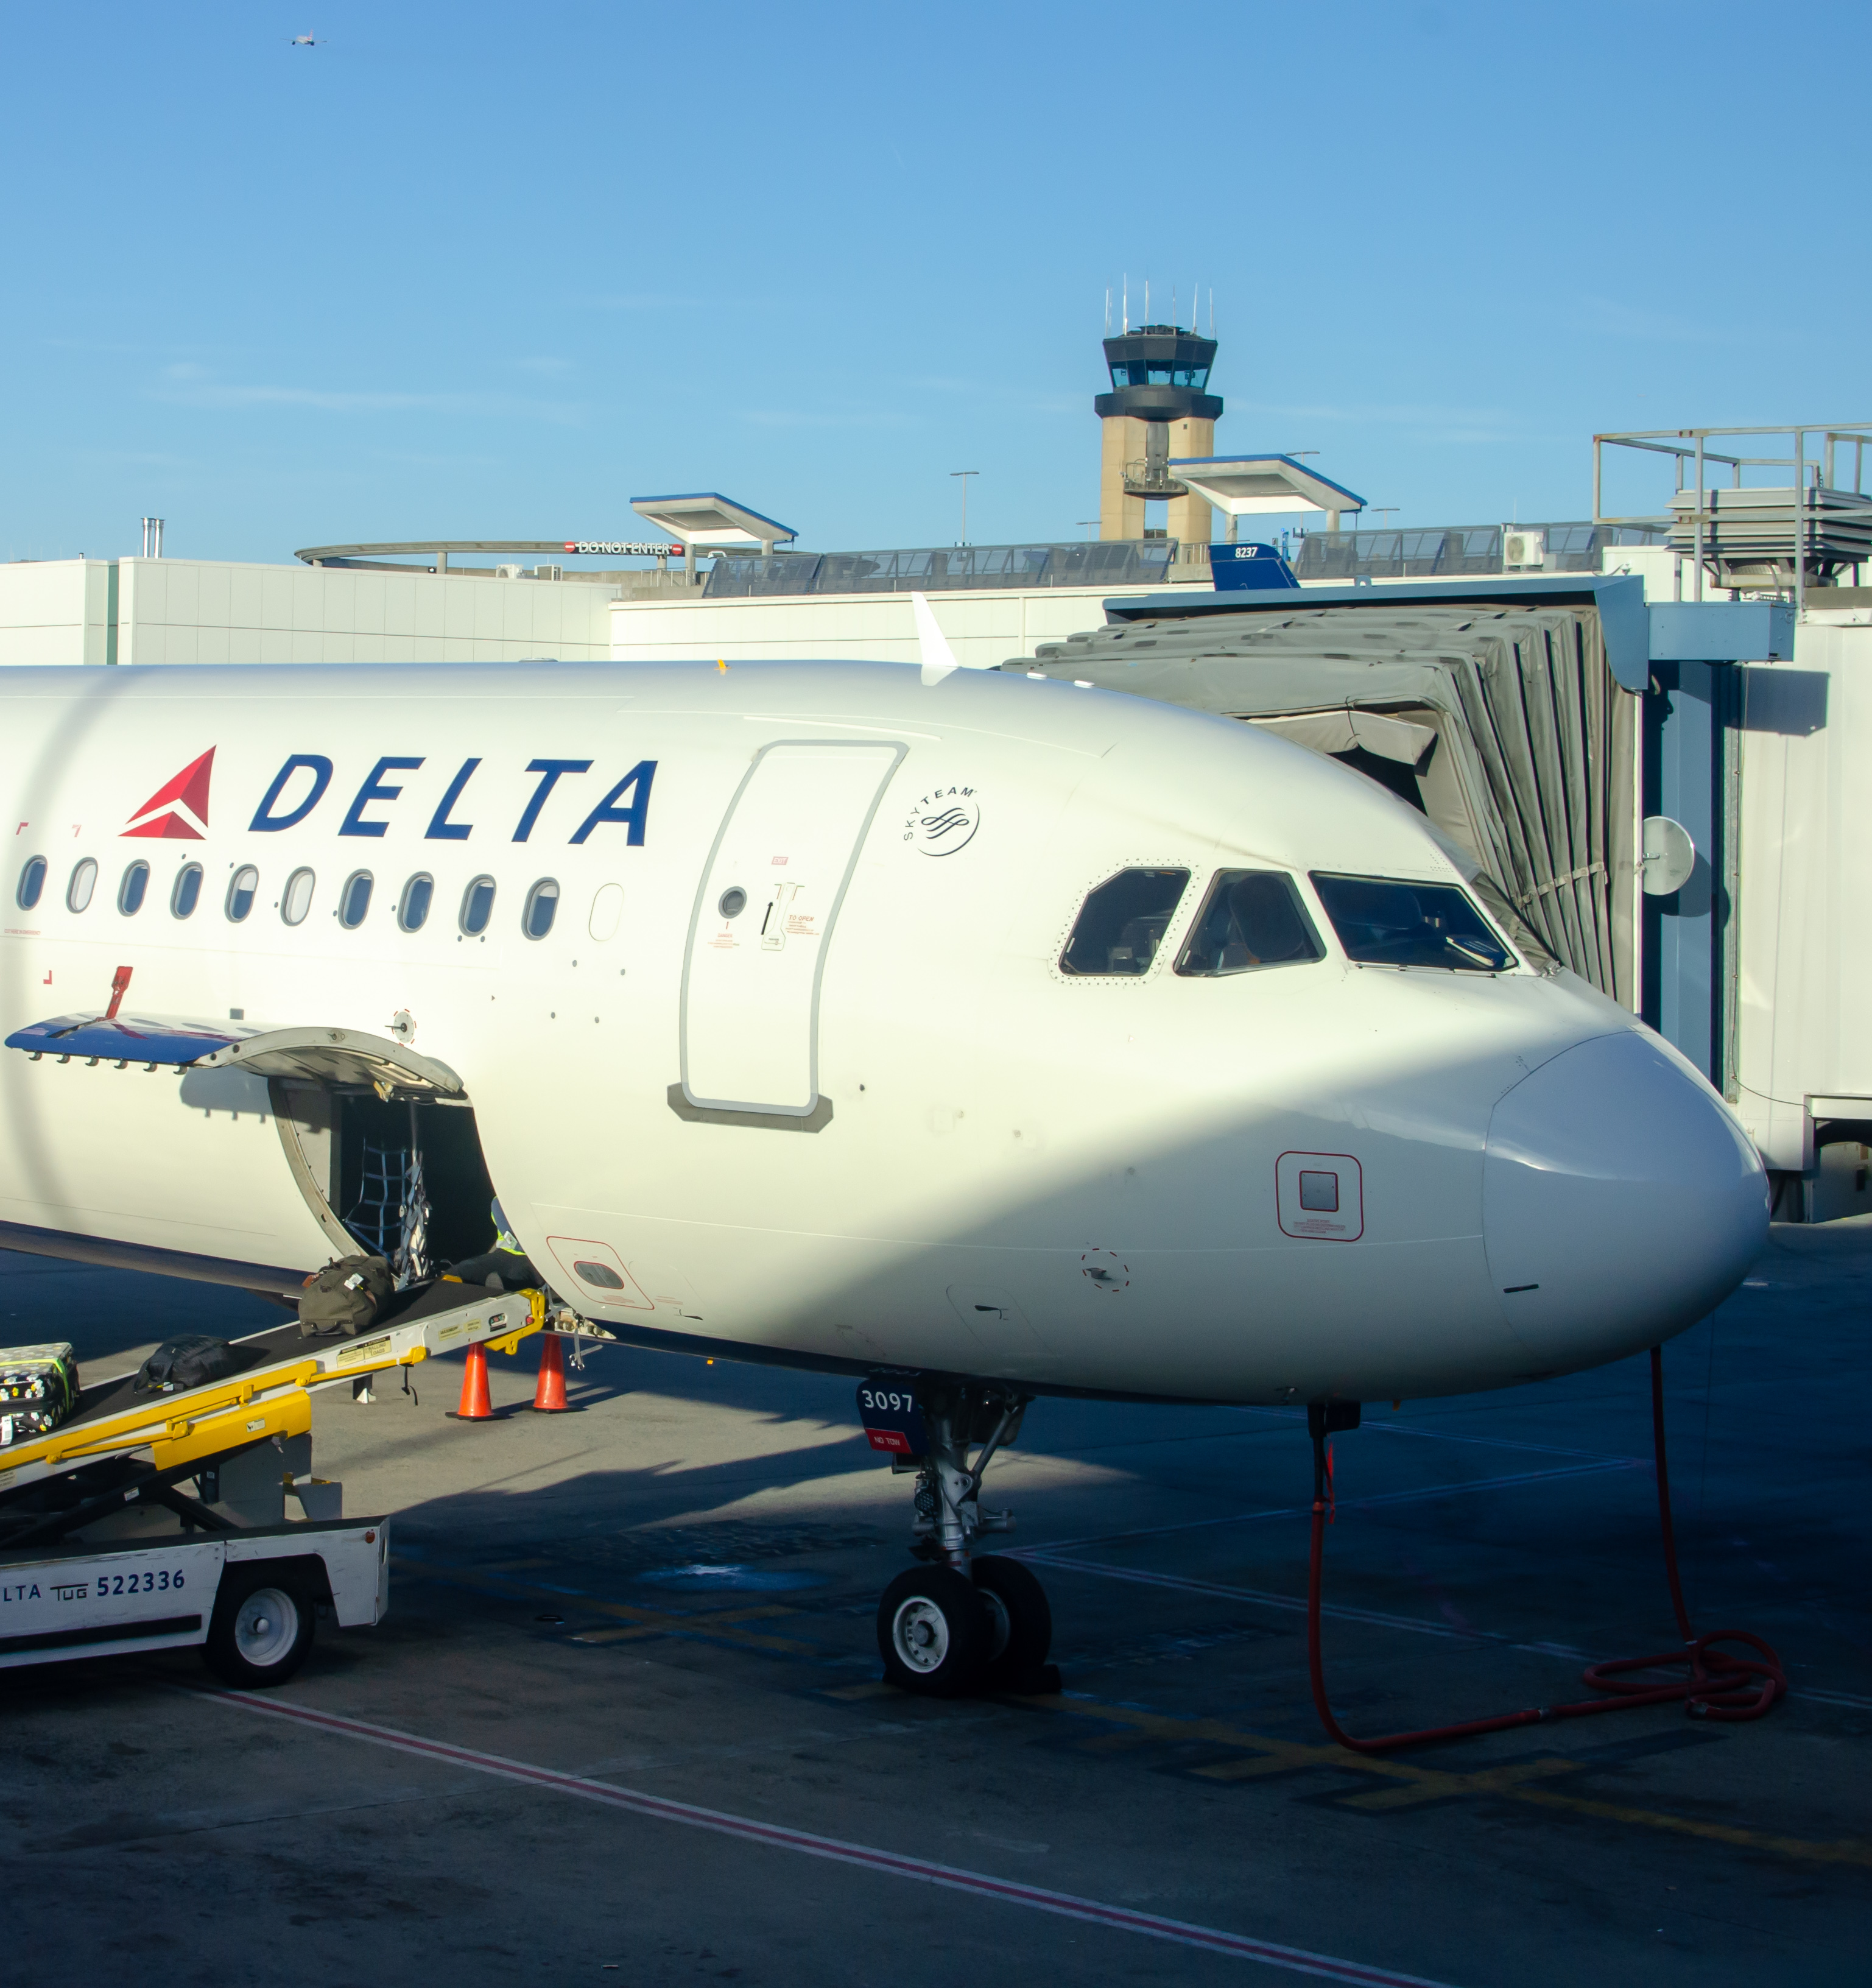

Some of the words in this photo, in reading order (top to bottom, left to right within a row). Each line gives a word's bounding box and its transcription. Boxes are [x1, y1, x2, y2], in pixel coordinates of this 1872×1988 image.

[579, 541, 598, 553] DO
[602, 542, 630, 554] NOT
[632, 543, 669, 555] ENTER
[1235, 547, 1258, 558] 8237
[248, 754, 658, 846] DELTA
[904, 787, 974, 841] SKYTEAM
[862, 1390, 912, 1412] 3097
[885, 1437, 900, 1446] TOW
[50, 1583, 89, 1601] TUG
[97, 1569, 185, 1596] 522336
